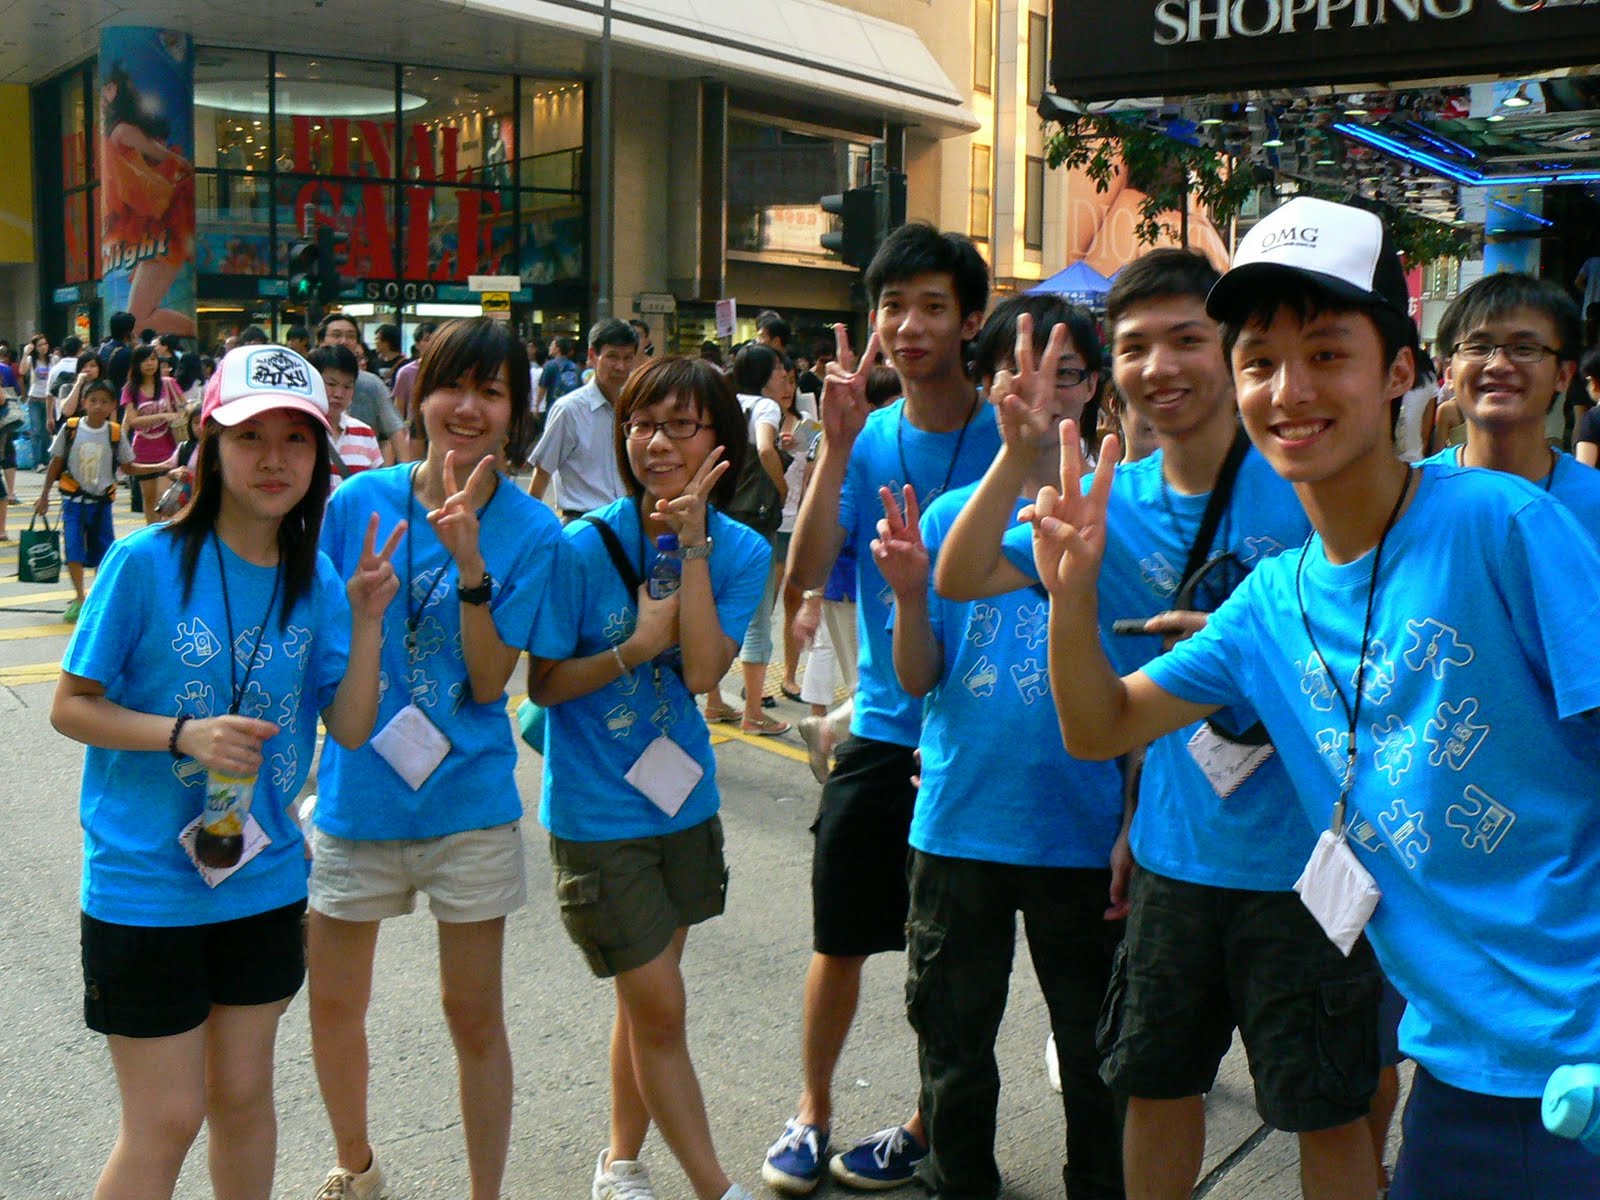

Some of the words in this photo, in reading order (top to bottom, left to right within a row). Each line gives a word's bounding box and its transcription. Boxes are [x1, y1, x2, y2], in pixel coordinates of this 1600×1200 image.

[292, 115, 474, 187] FINAL
[1261, 227, 1319, 248] OMG
[367, 282, 435, 300] SOGO
